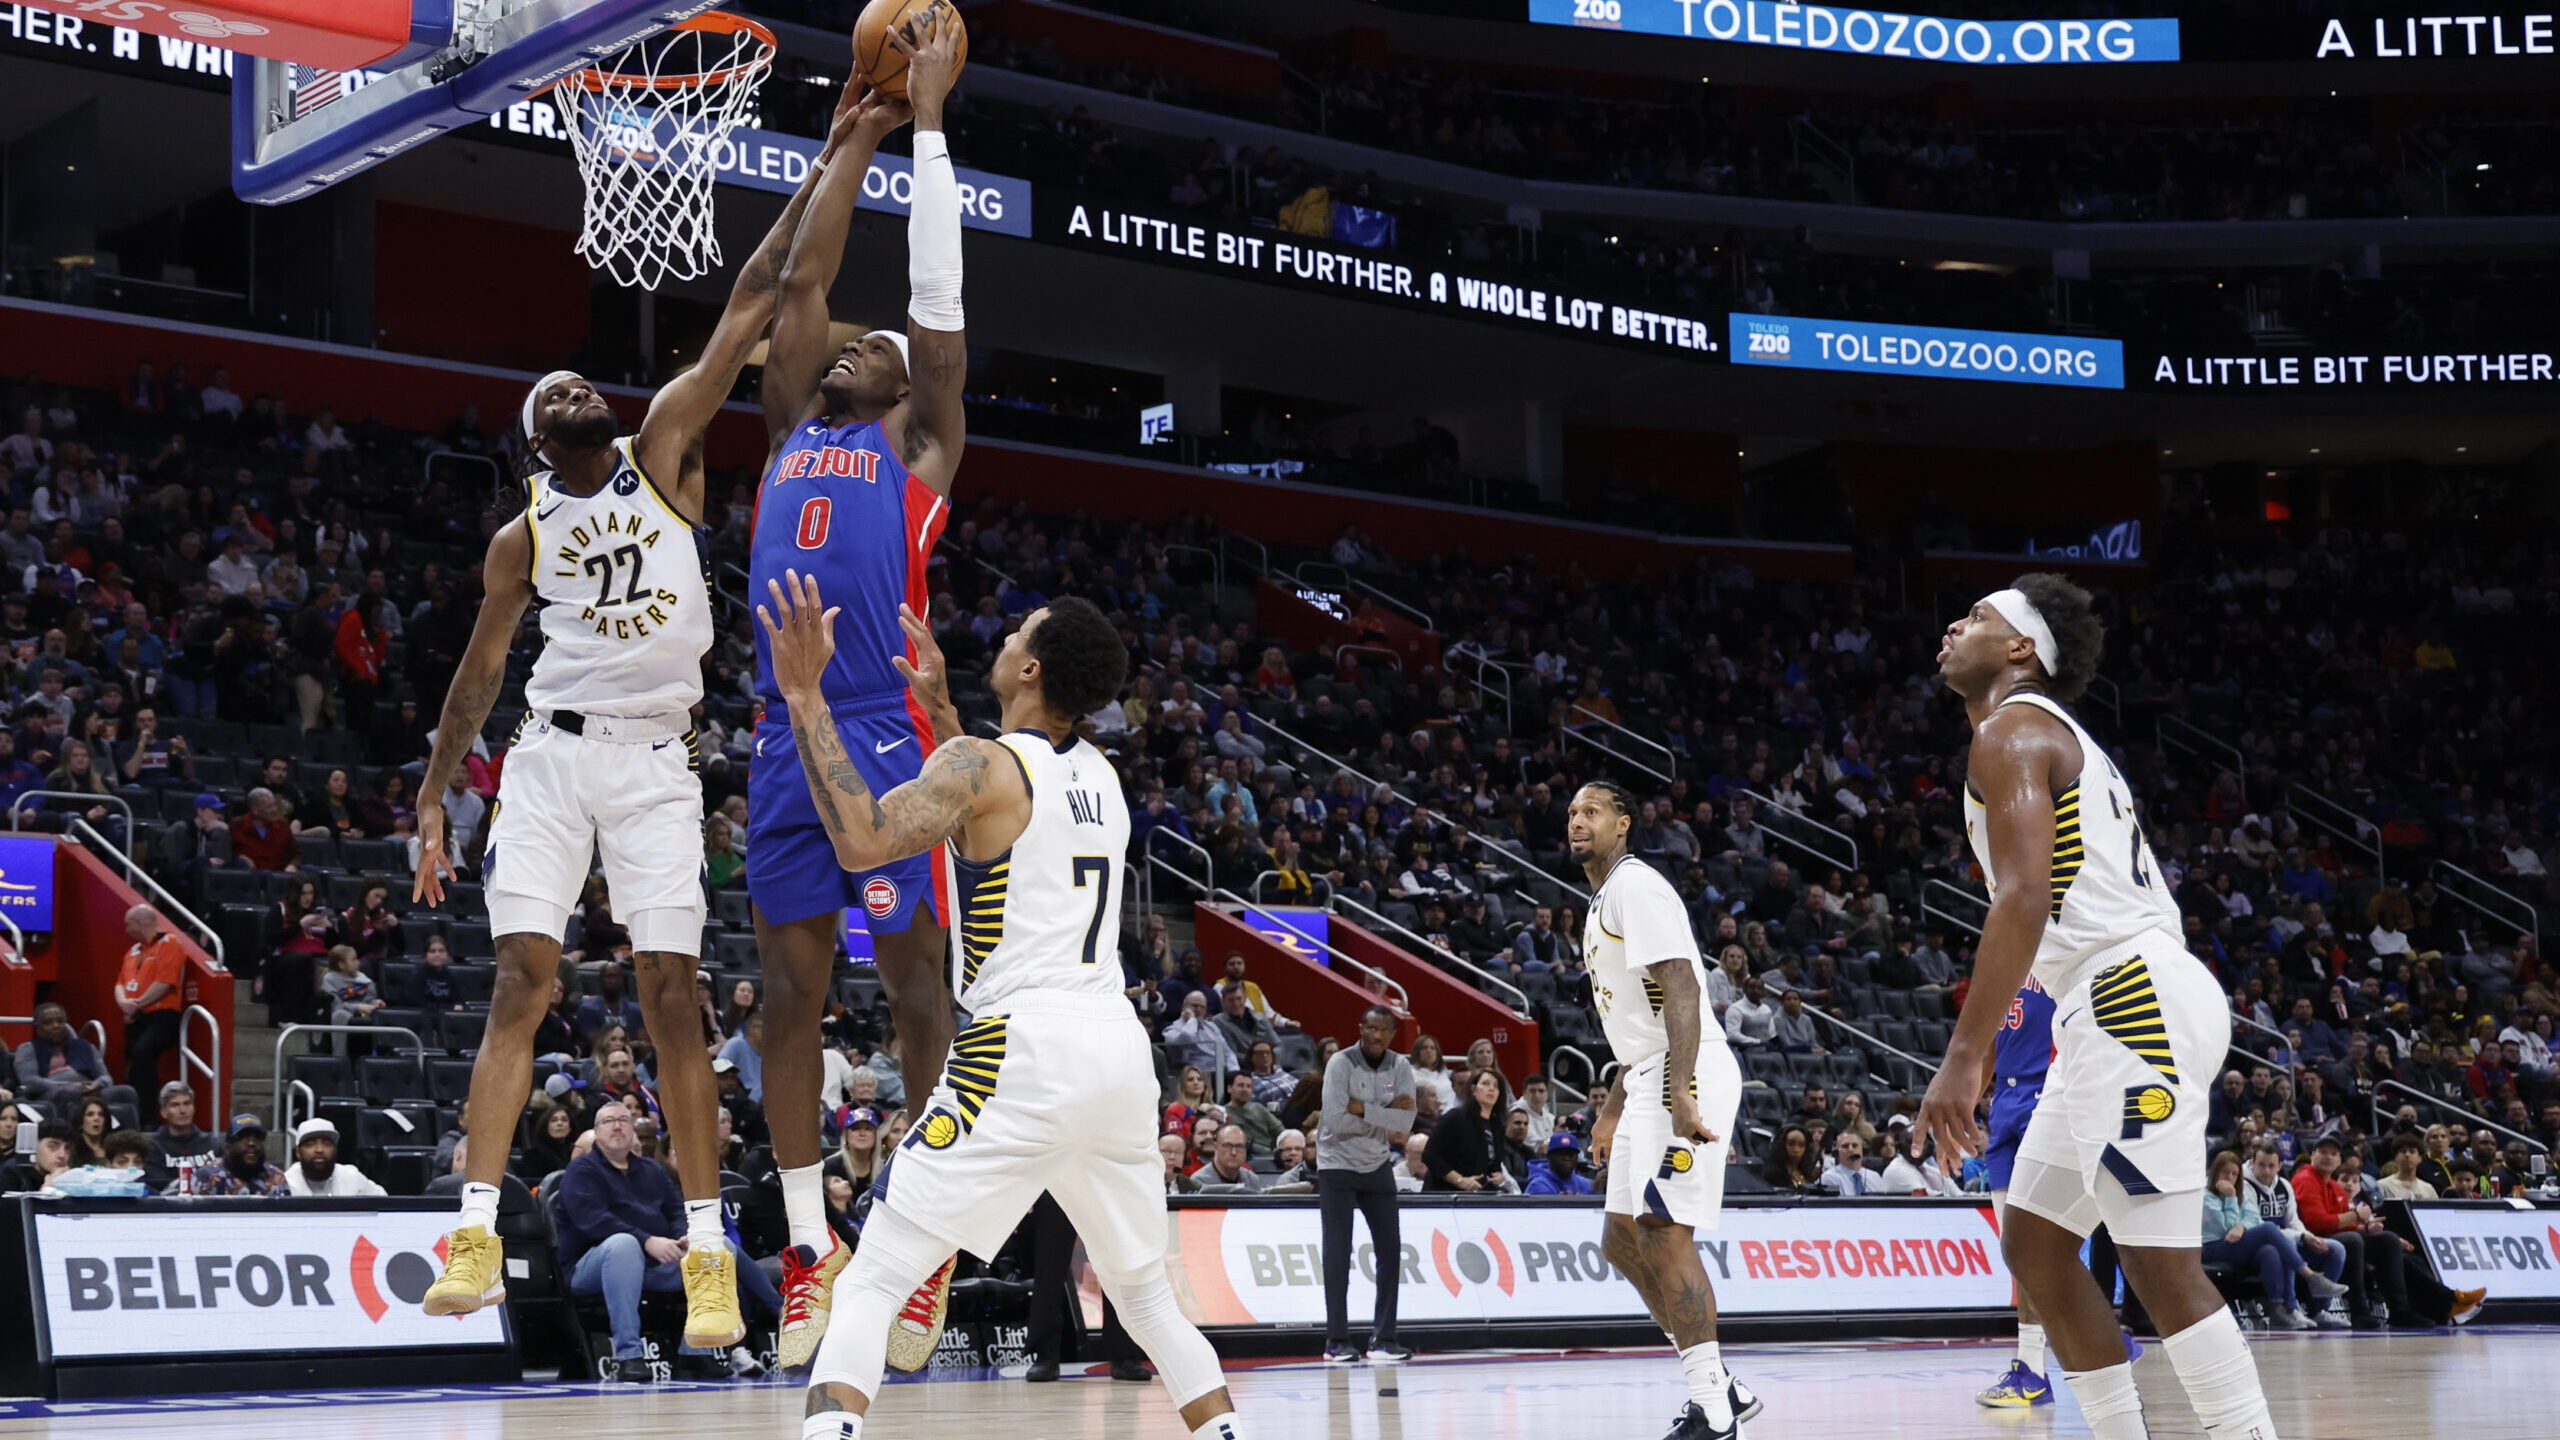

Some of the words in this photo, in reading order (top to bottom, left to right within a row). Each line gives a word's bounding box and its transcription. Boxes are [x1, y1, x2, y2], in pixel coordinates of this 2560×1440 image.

[113, 26, 139, 60] A
[601, 22, 665, 55] DRAFTKINGS
[1673, 0, 2136, 63] TOLEDOZOO.ORG
[2316, 19, 2355, 58] A
[2375, 15, 2555, 57] LITTLE
[529, 57, 592, 87] DRAFTKINGS
[1067, 205, 1093, 239] A
[1102, 210, 1206, 259] LITTLE
[1216, 232, 1265, 269] BIT
[1275, 243, 1421, 299] FURTHER.
[1429, 272, 1447, 304] A
[1456, 276, 1547, 322] WHOLE
[1555, 295, 1604, 332] LOT
[1611, 306, 1718, 352] BETTER.
[1748, 322, 1790, 335] TOLEDO
[1748, 333, 1791, 354] ZOO
[1815, 332, 2098, 379] TOLEDOZOO.ORG
[2154, 355, 2177, 383] A
[2186, 356, 2300, 385] LITTLE
[2313, 356, 2369, 384] BIT
[2383, 353, 2560, 383] FURTHER.
[555, 510, 662, 578] INDIANA
[796, 496, 832, 550] 0
[583, 543, 653, 609] 22
[581, 588, 678, 640] PACERS
[1065, 788, 1104, 826] HILL
[867, 890, 891, 898] DETROIT
[868, 897, 892, 905] PISTONS
[1071, 854, 1111, 964] 7
[1738, 1238, 1993, 1280] RESTORATION
[2430, 1236, 2552, 1270] BELFOR
[65, 1254, 335, 1311] BELFOR
